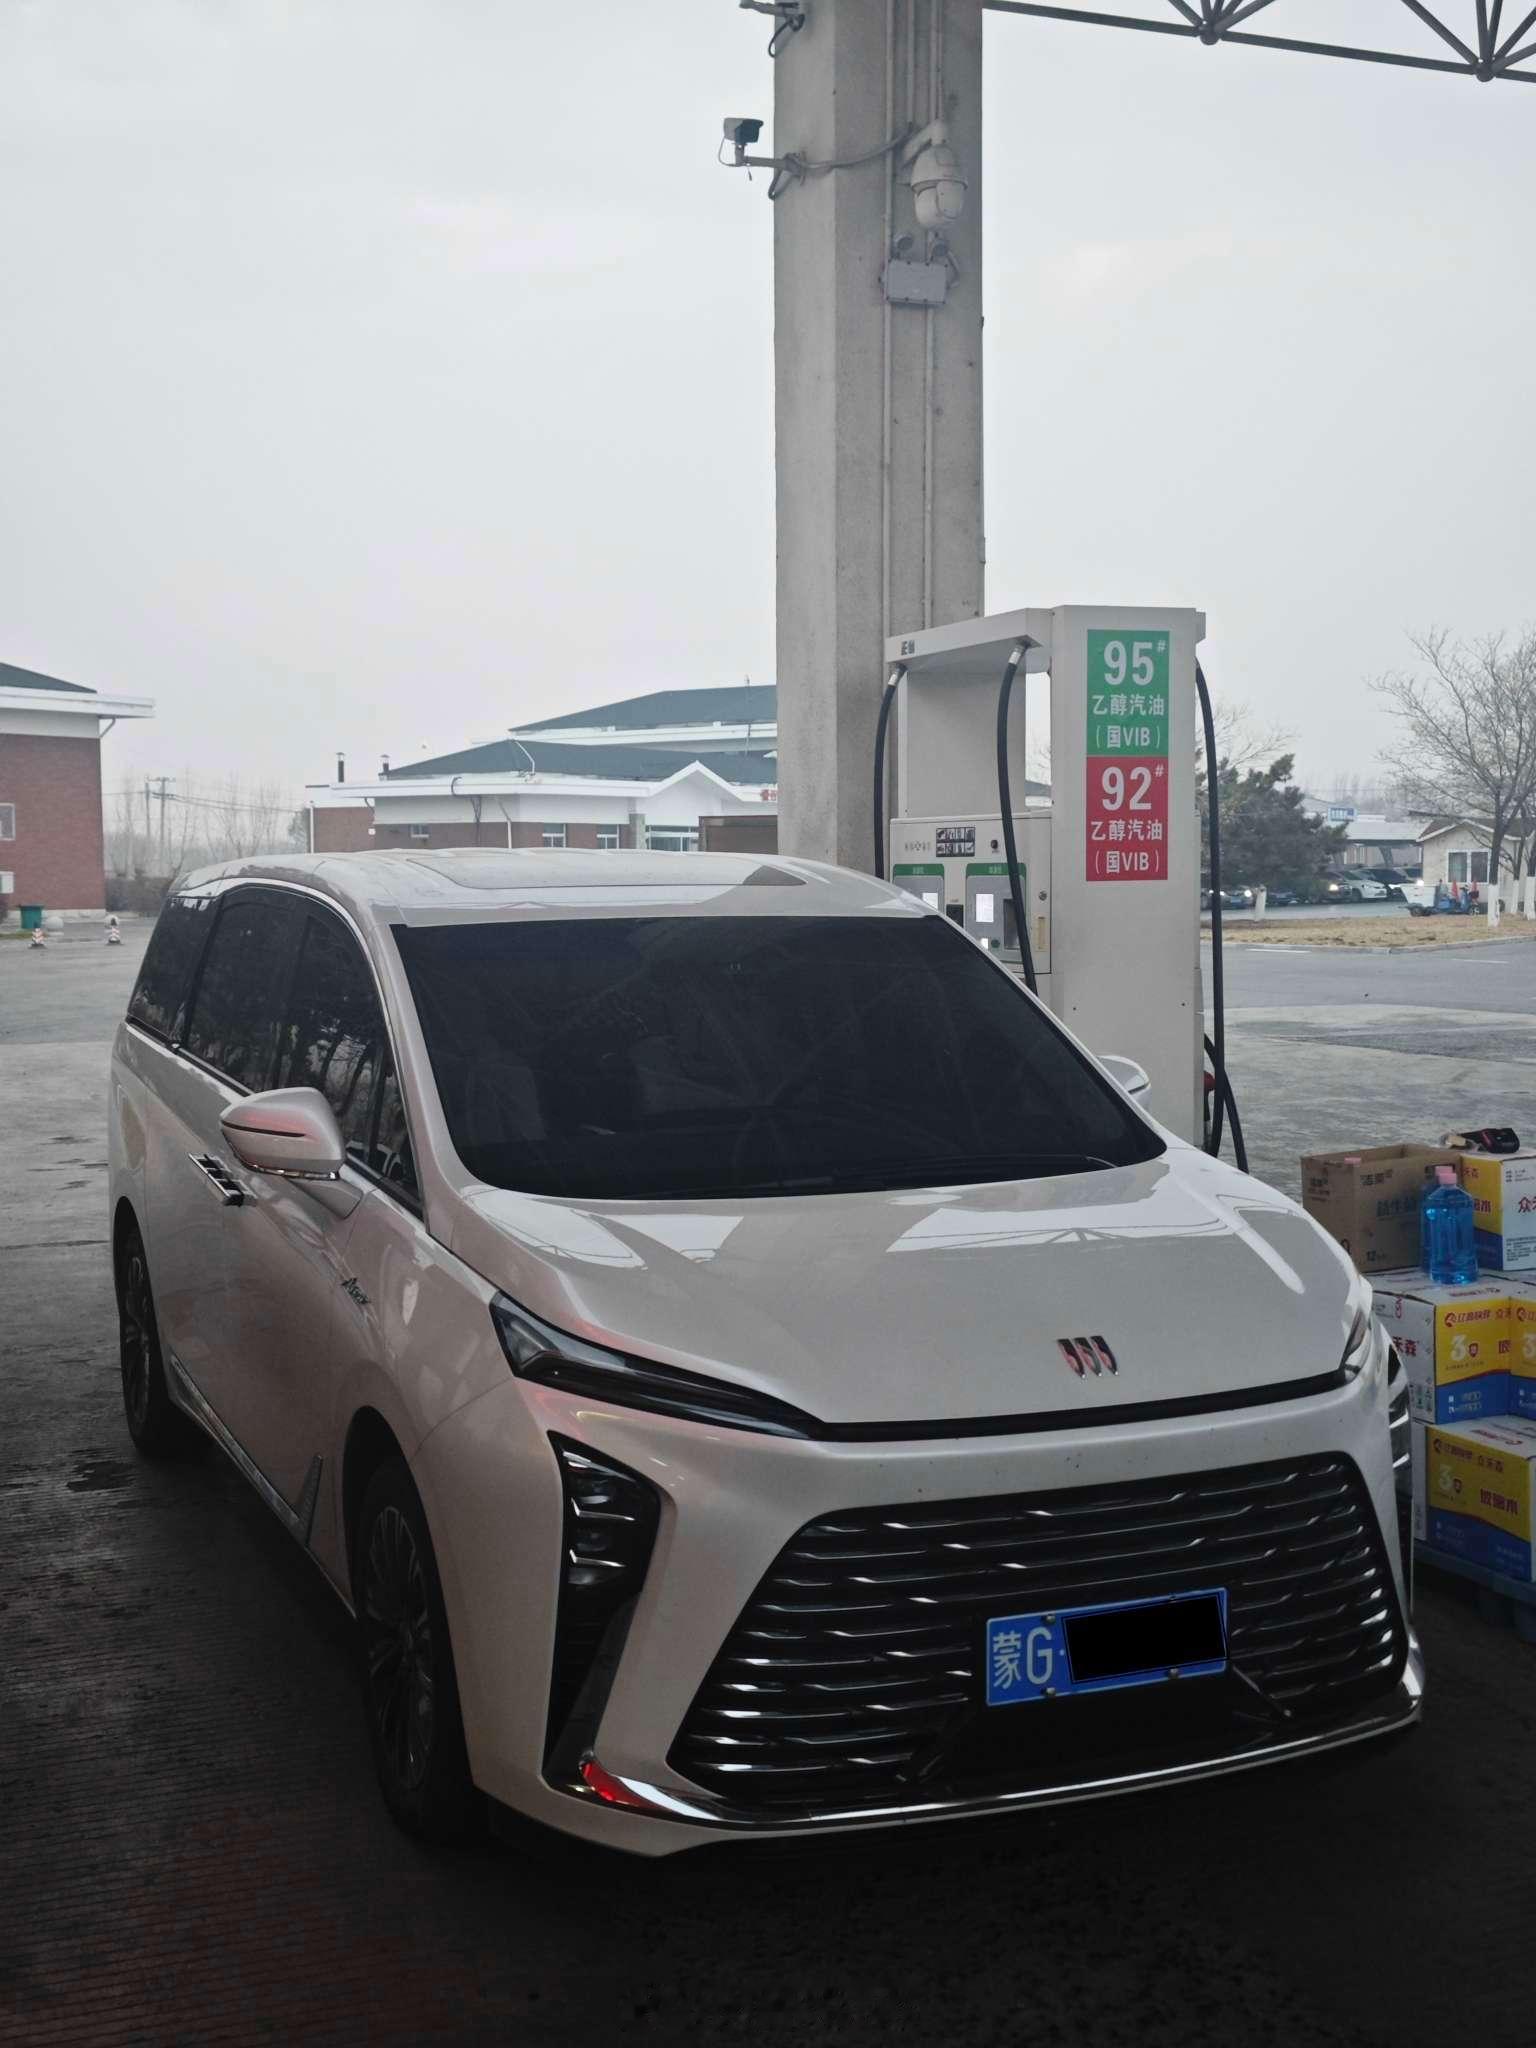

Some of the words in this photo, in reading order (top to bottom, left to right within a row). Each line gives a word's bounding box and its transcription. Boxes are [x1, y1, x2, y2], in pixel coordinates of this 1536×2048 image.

[1092, 694, 1165, 717] 乙醇汽油
[1090, 820, 1163, 842] 乙醇汽油
